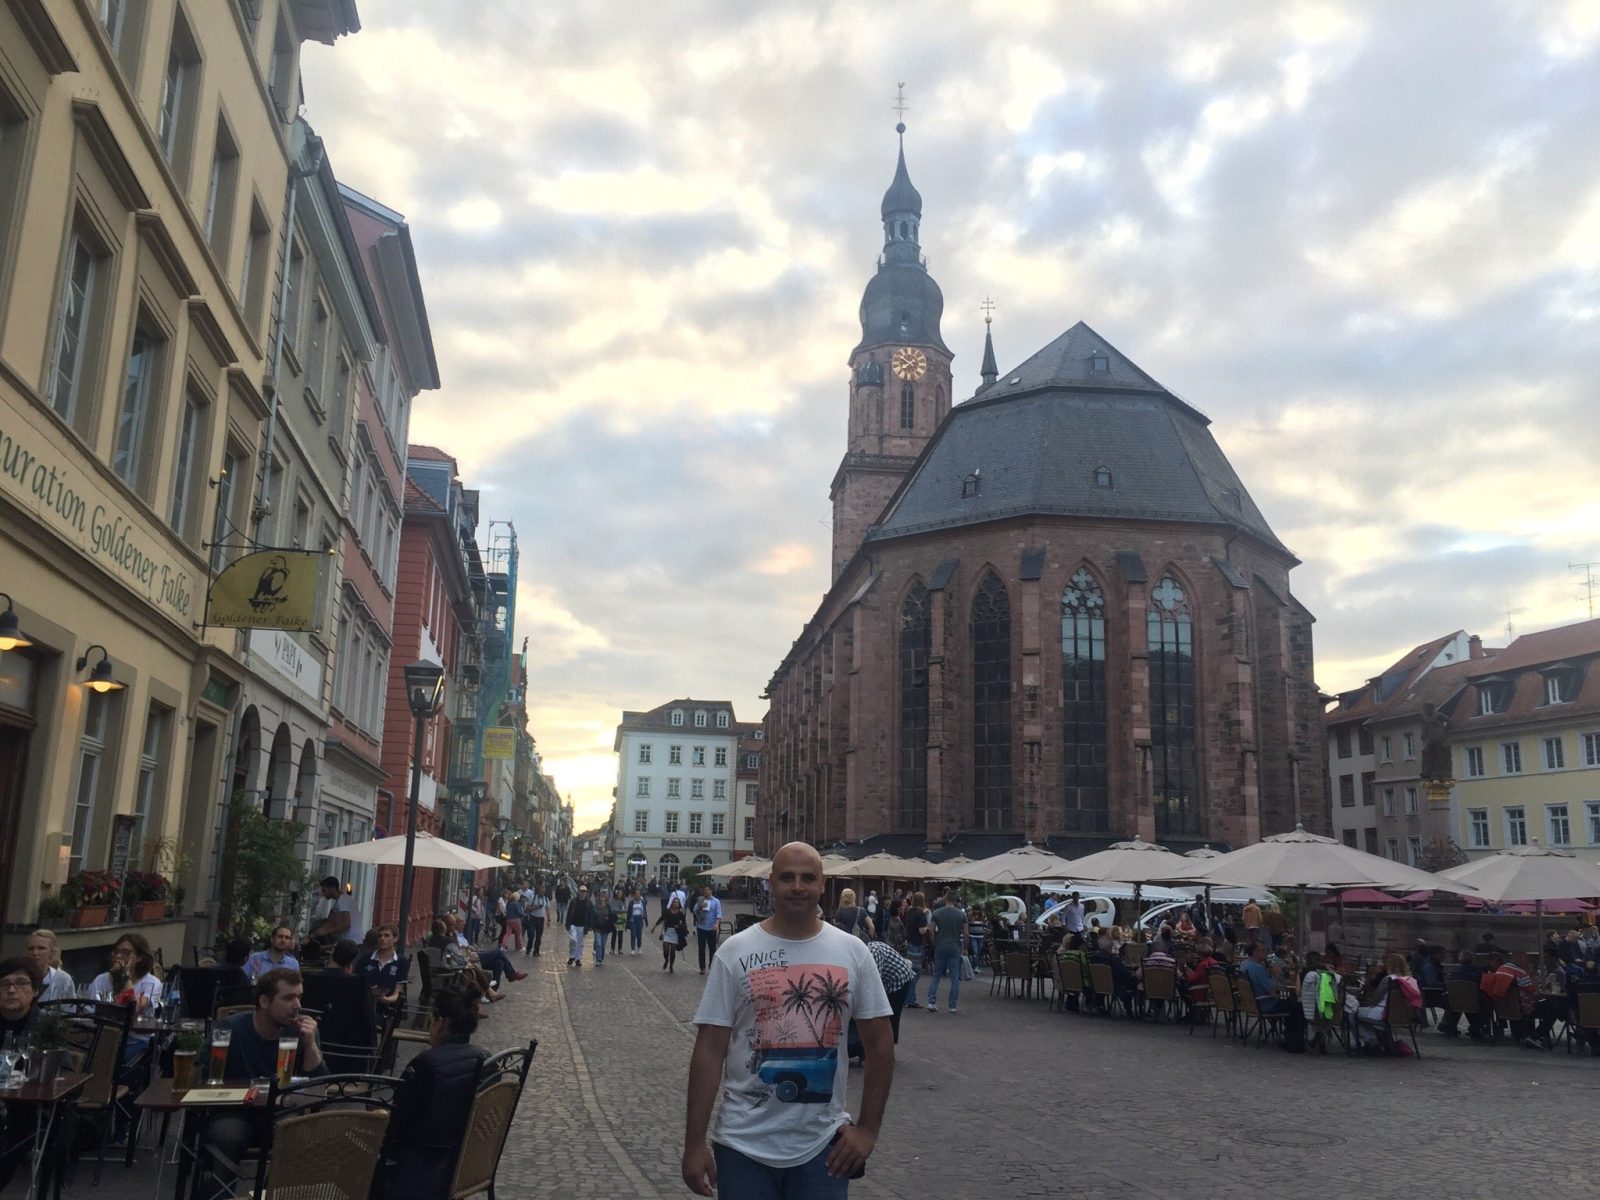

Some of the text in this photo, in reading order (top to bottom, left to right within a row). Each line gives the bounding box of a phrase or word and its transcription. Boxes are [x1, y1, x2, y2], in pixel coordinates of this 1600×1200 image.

[0, 429, 190, 617] uration Goldener Falke
[213, 612, 308, 627] Goldener Falke
[739, 949, 786, 974] VENICE
[760, 960, 789, 971] STYLE
